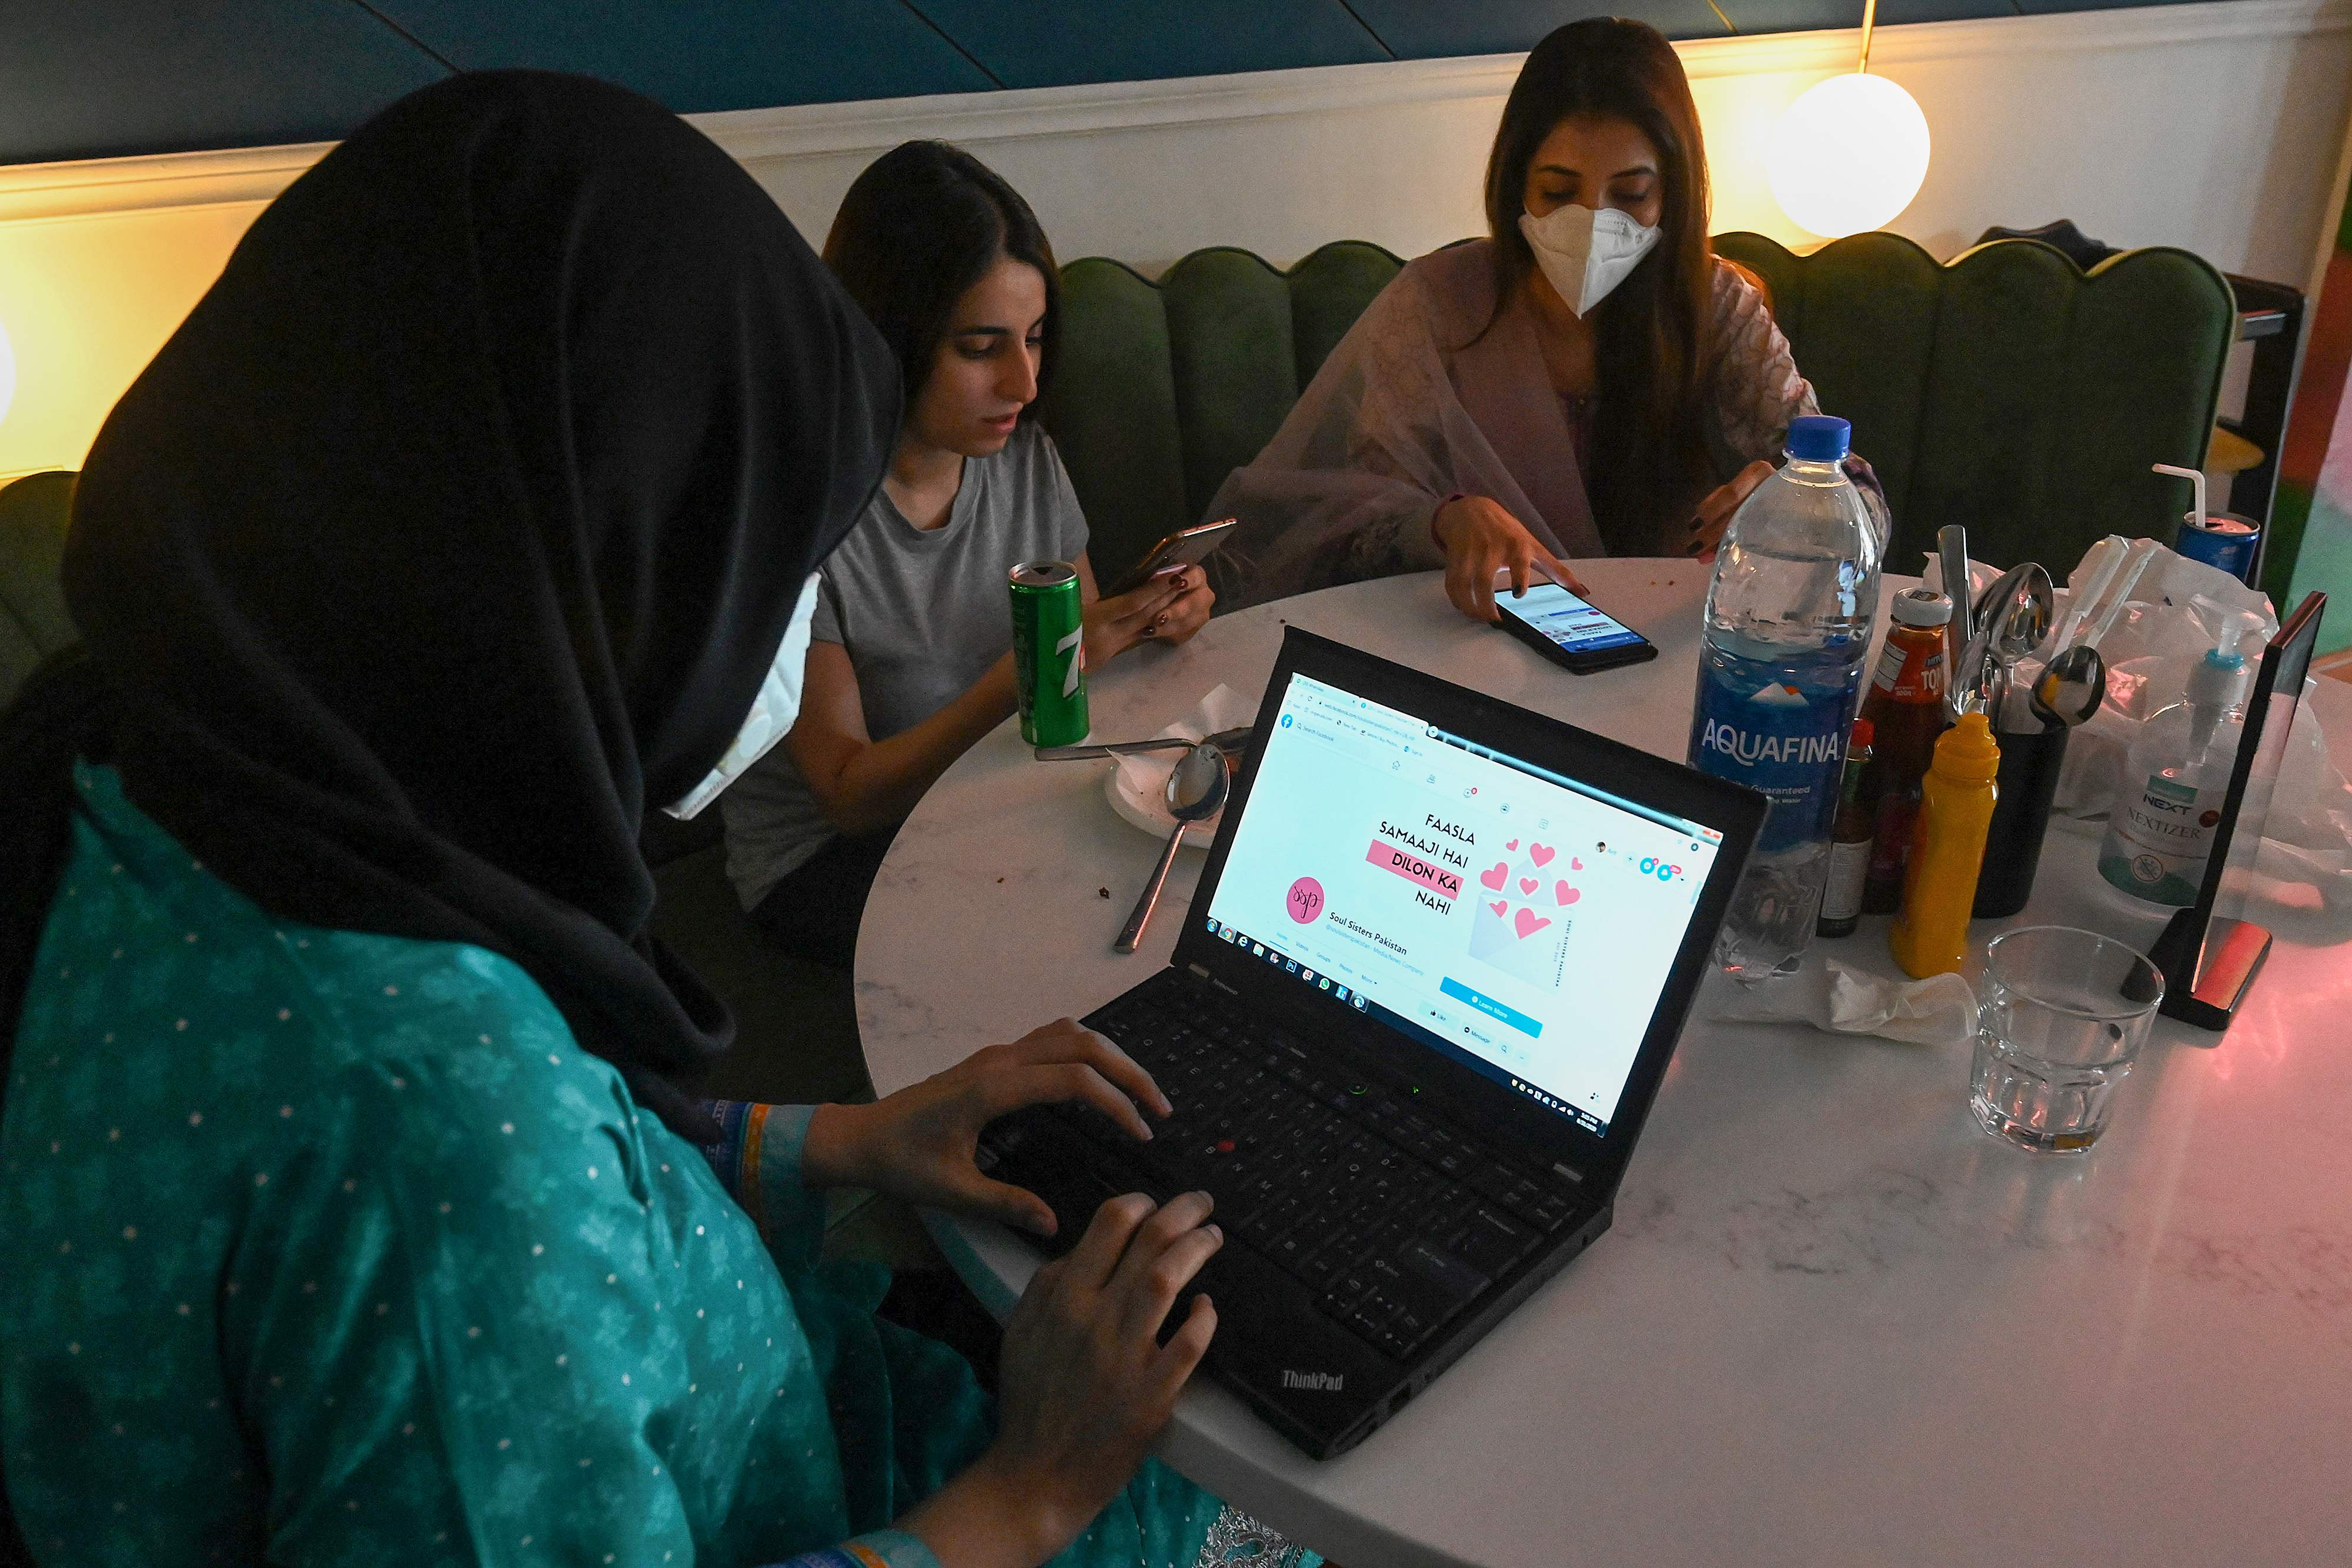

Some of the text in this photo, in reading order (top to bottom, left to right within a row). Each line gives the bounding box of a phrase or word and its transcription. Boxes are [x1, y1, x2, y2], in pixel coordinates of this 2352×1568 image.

[1702, 717, 1839, 766] AQUAFINA
[2143, 794, 2193, 815] NEXT
[1425, 814, 1475, 845] FAASLA
[2127, 806, 2201, 840] NEXTIZER
[1379, 821, 1468, 868] SAMAAJI HAI
[1391, 852, 1457, 892] DILON KA
[1415, 890, 1451, 915] NAHI
[1329, 912, 1407, 955] Soul Sisters Pakistan
[1478, 1000, 1494, 1012] Learn
[1283, 1369, 1344, 1391] ThinkPad
